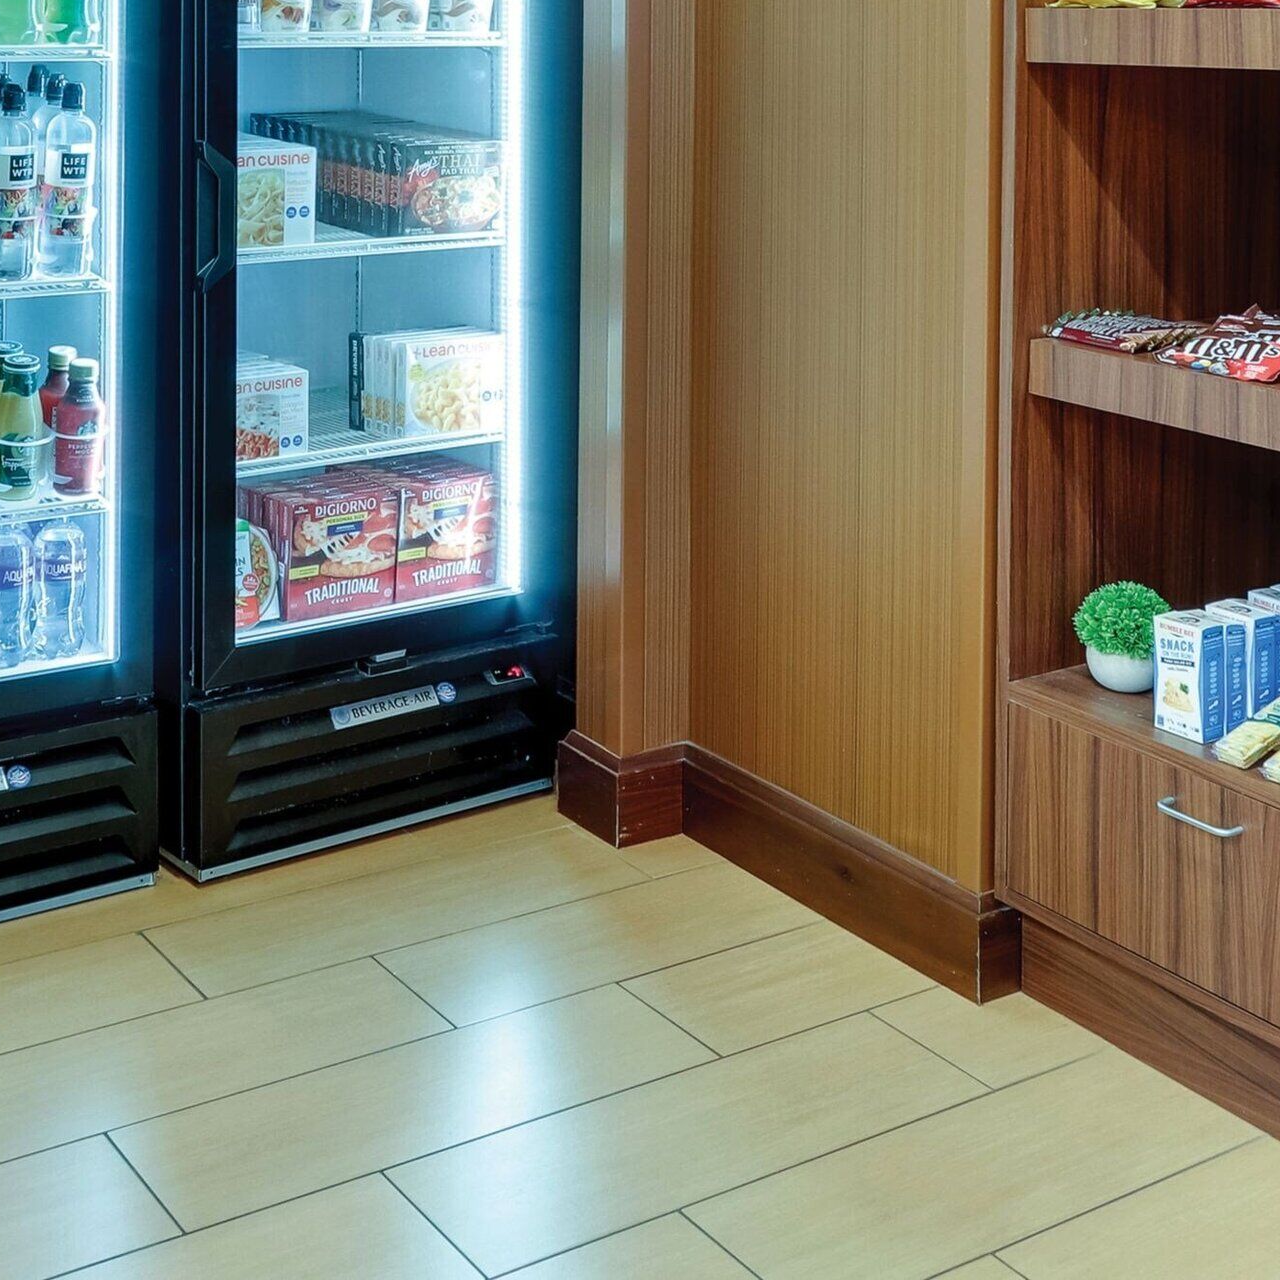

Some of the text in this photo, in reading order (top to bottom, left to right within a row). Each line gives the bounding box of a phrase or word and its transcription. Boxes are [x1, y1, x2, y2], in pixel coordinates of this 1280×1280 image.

[315, 497, 377, 518] DIGIORNO
[412, 559, 482, 587] TRADITIONAL
[305, 577, 380, 605] TRADITIONAL
[1160, 638, 1195, 653] SNACK
[351, 690, 435, 719] BEVERAGE-AIR
